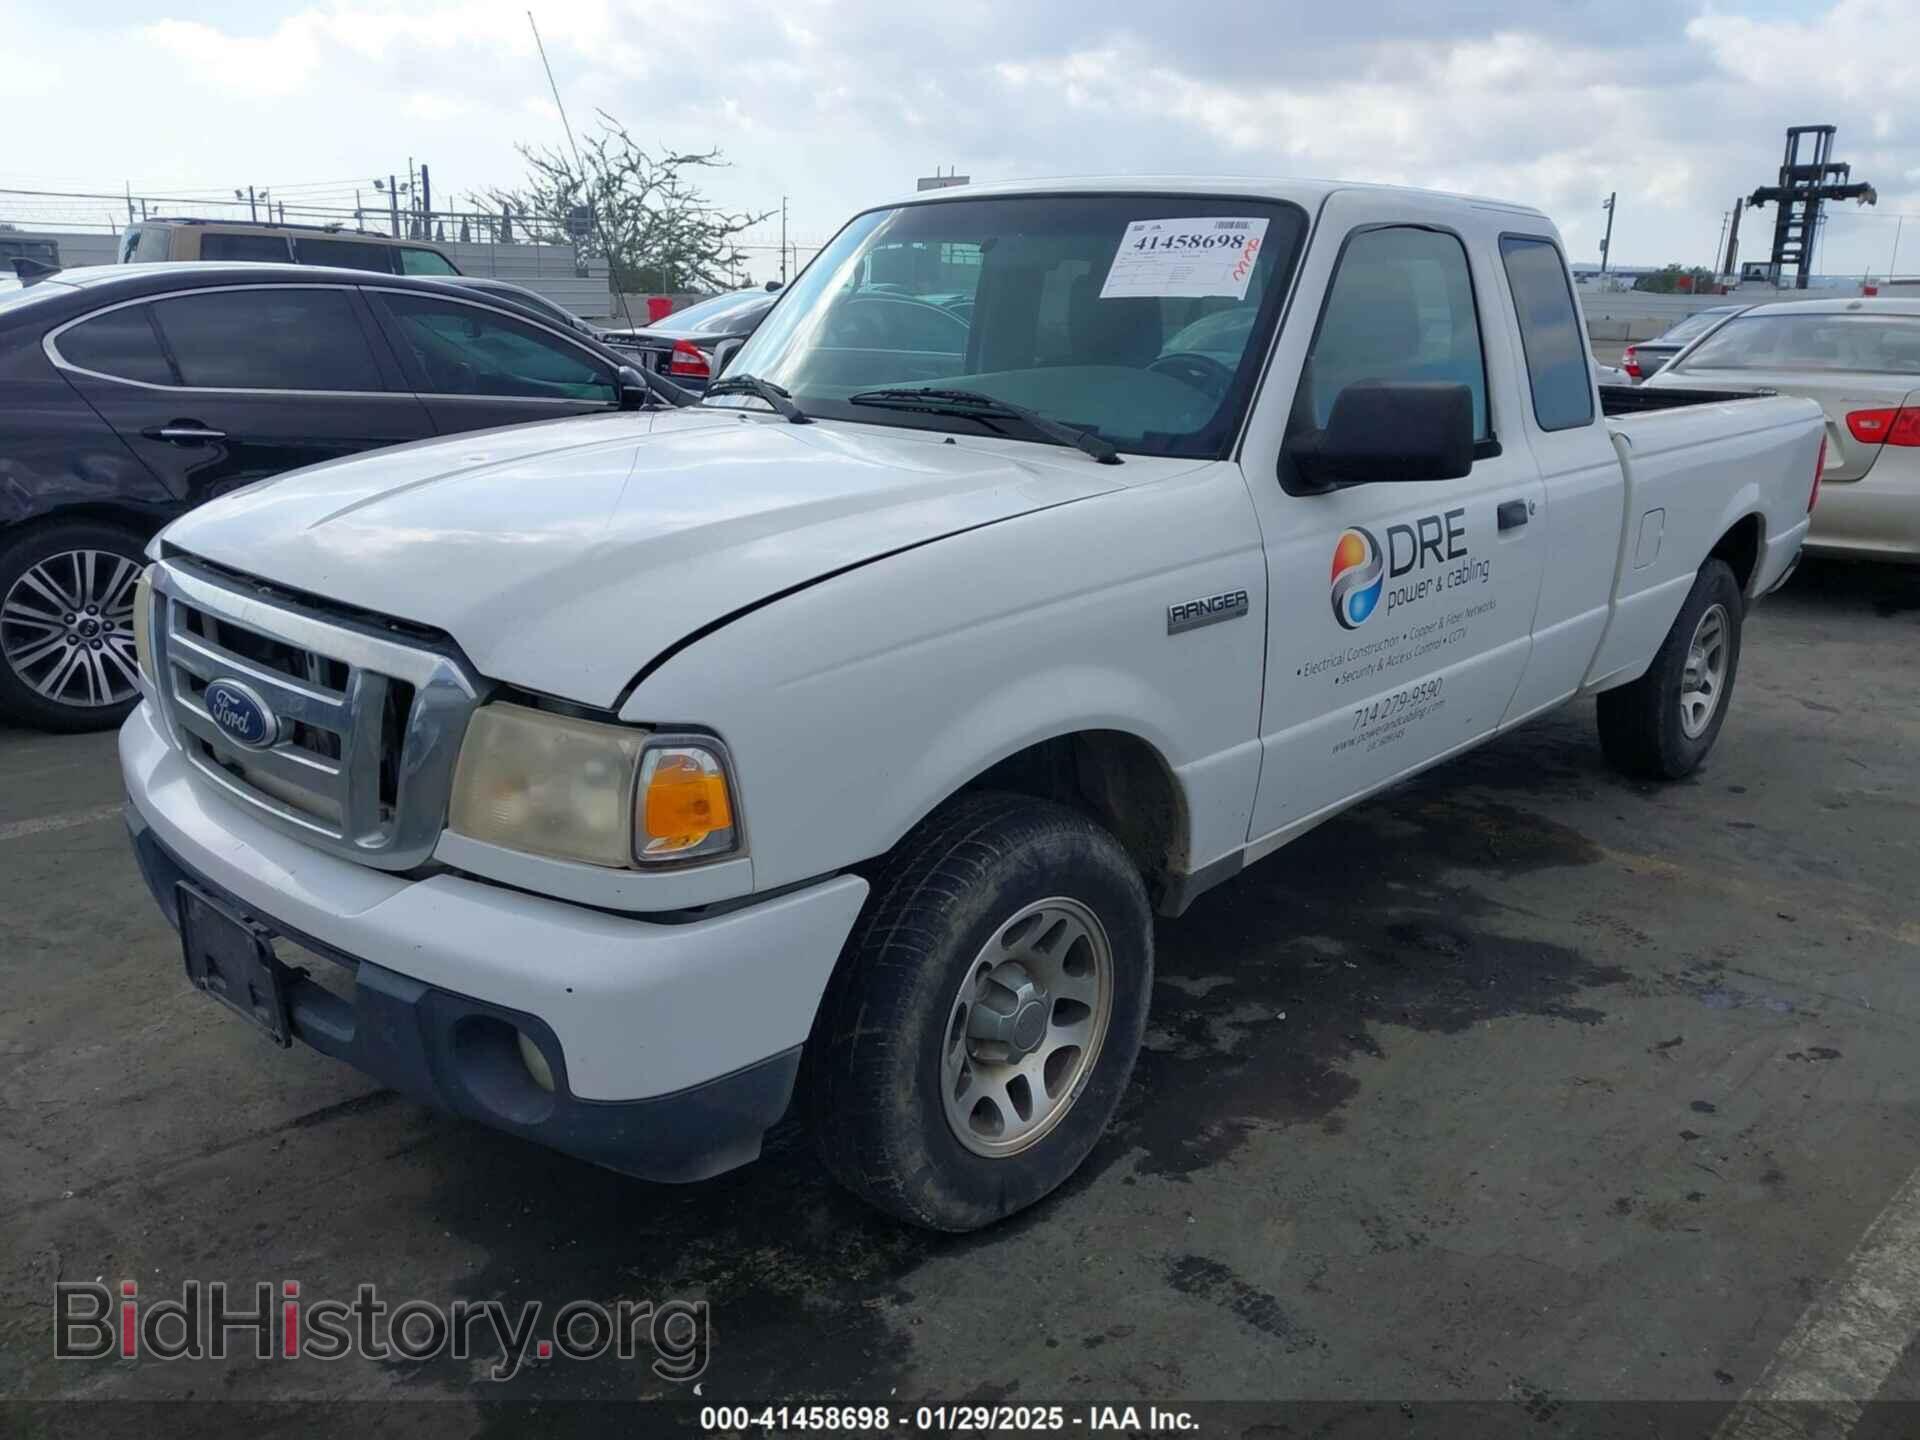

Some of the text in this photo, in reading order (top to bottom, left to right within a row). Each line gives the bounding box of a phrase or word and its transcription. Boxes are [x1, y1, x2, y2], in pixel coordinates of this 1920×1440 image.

[1133, 233, 1246, 250] 41458698
[1386, 507, 1468, 579] DRE
[1171, 590, 1249, 622] RANGER
[1387, 557, 1490, 617] power & cabling
[1303, 648, 1346, 677] Electrical
[1347, 635, 1400, 662] Construction
[1342, 661, 1375, 686] Security
[213, 689, 250, 734] Ford
